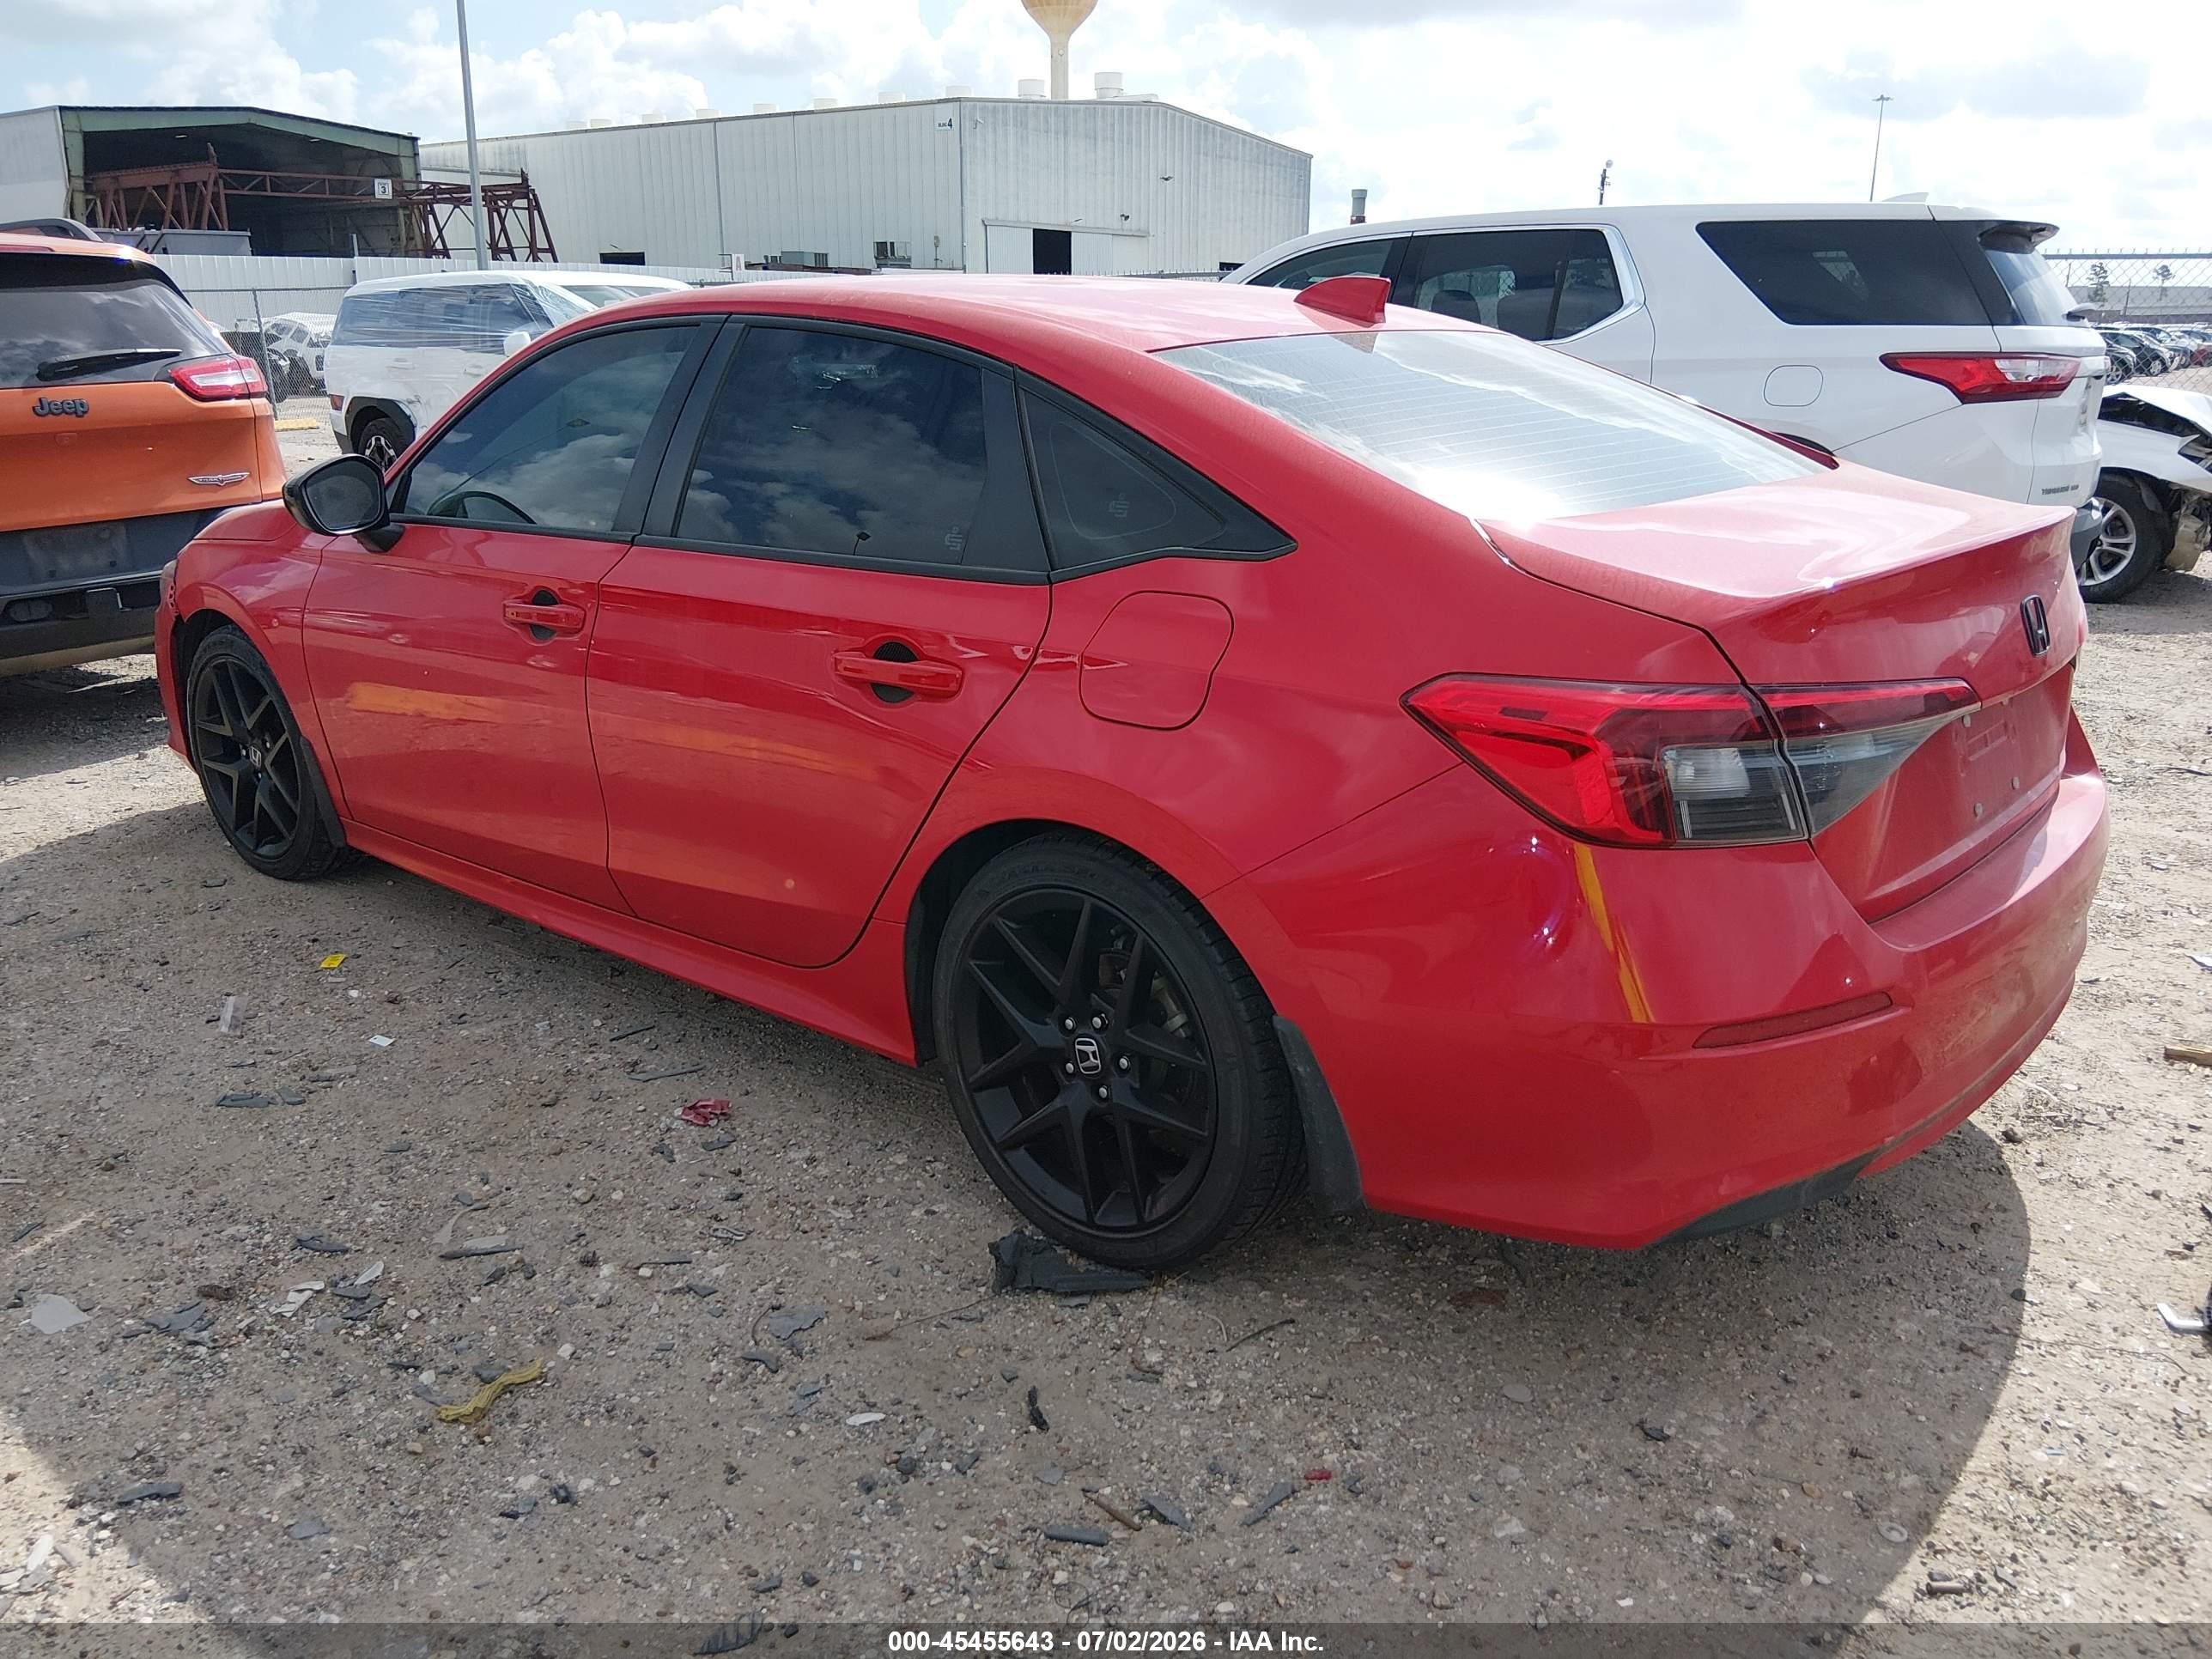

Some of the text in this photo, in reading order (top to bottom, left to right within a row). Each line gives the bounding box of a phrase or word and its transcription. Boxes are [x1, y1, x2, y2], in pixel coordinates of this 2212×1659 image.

[947, 118, 953, 129] 4
[380, 185, 386, 194] 3
[32, 397, 90, 418] Jeep
